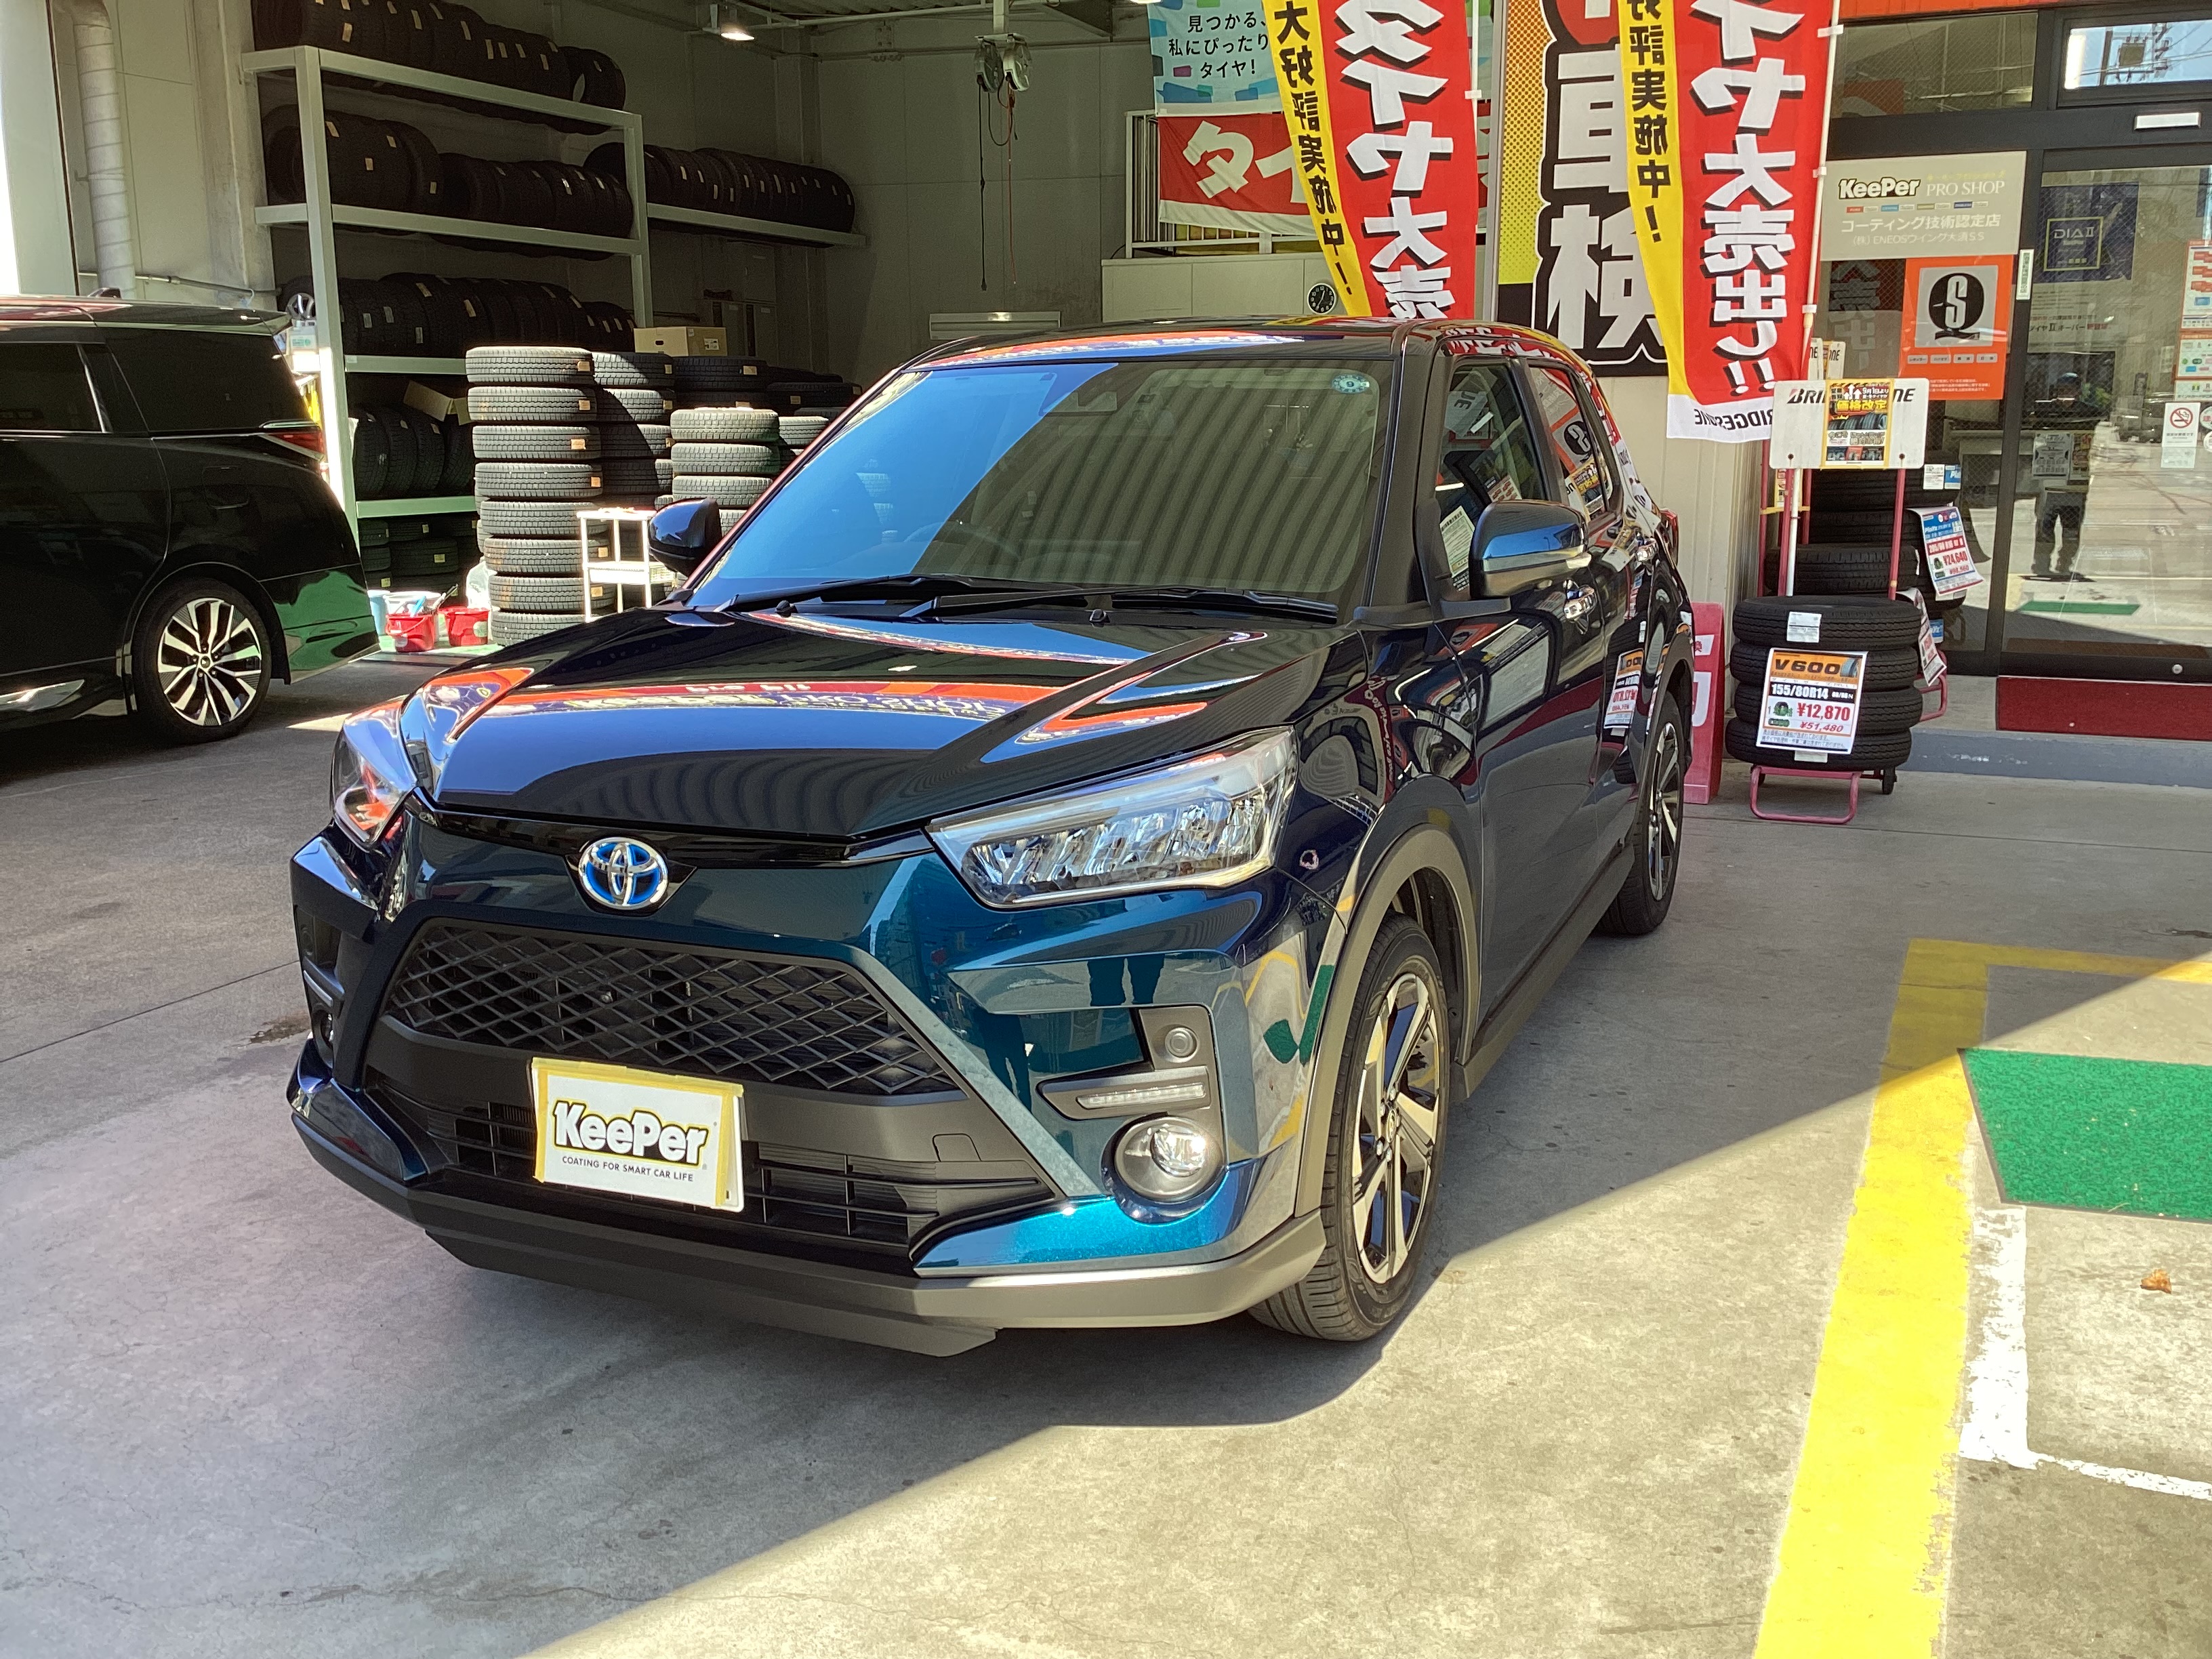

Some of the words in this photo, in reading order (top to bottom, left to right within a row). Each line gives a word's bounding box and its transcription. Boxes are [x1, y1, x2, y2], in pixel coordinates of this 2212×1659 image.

[1169, 29, 1268, 56] 私にぴったり
[1839, 177, 1921, 199] KeePer
[1927, 182, 1959, 196] PRO
[1962, 180, 2005, 195] SHOP
[1841, 214, 2001, 232] コーティング技術認定店
[1837, 399, 1887, 411] 価格改定
[1775, 659, 1841, 674] V600
[1771, 683, 1829, 699] 155/80R14
[1797, 702, 1851, 721] ¥12,870
[1800, 721, 1844, 733] ¥51,480
[552, 1100, 708, 1166] KeePer
[562, 1155, 600, 1168] COATING
[602, 1162, 619, 1172] FOR
[623, 1164, 651, 1176] SMART
[654, 1168, 671, 1179] CAR
[673, 1171, 694, 1182] LIFE
